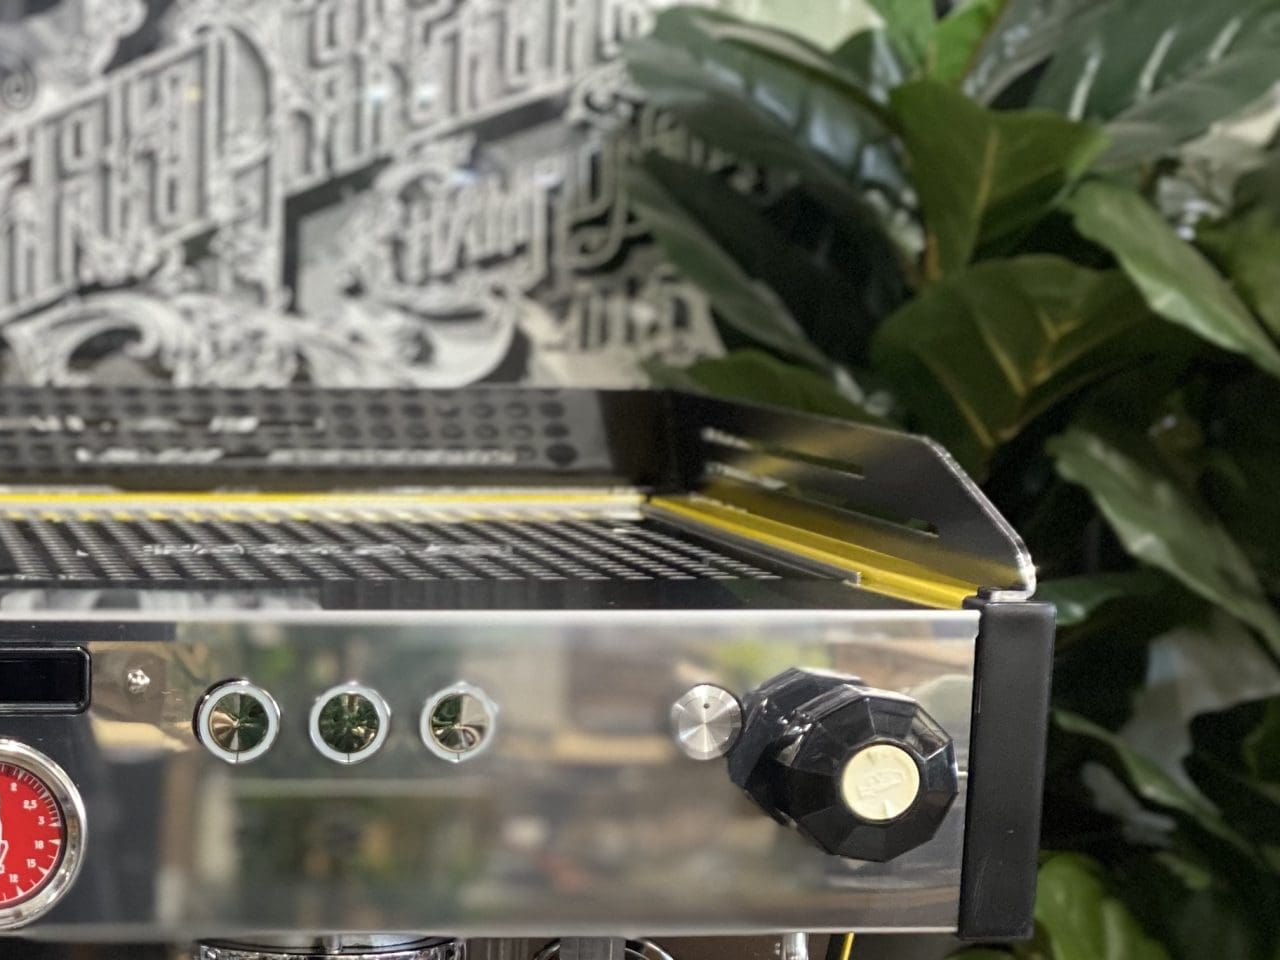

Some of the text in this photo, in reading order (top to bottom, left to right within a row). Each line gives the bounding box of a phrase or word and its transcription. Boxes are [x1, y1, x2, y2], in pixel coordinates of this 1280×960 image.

[10, 782, 18, 792] 2
[38, 815, 45, 826] 3
[26, 858, 37, 869] 15
